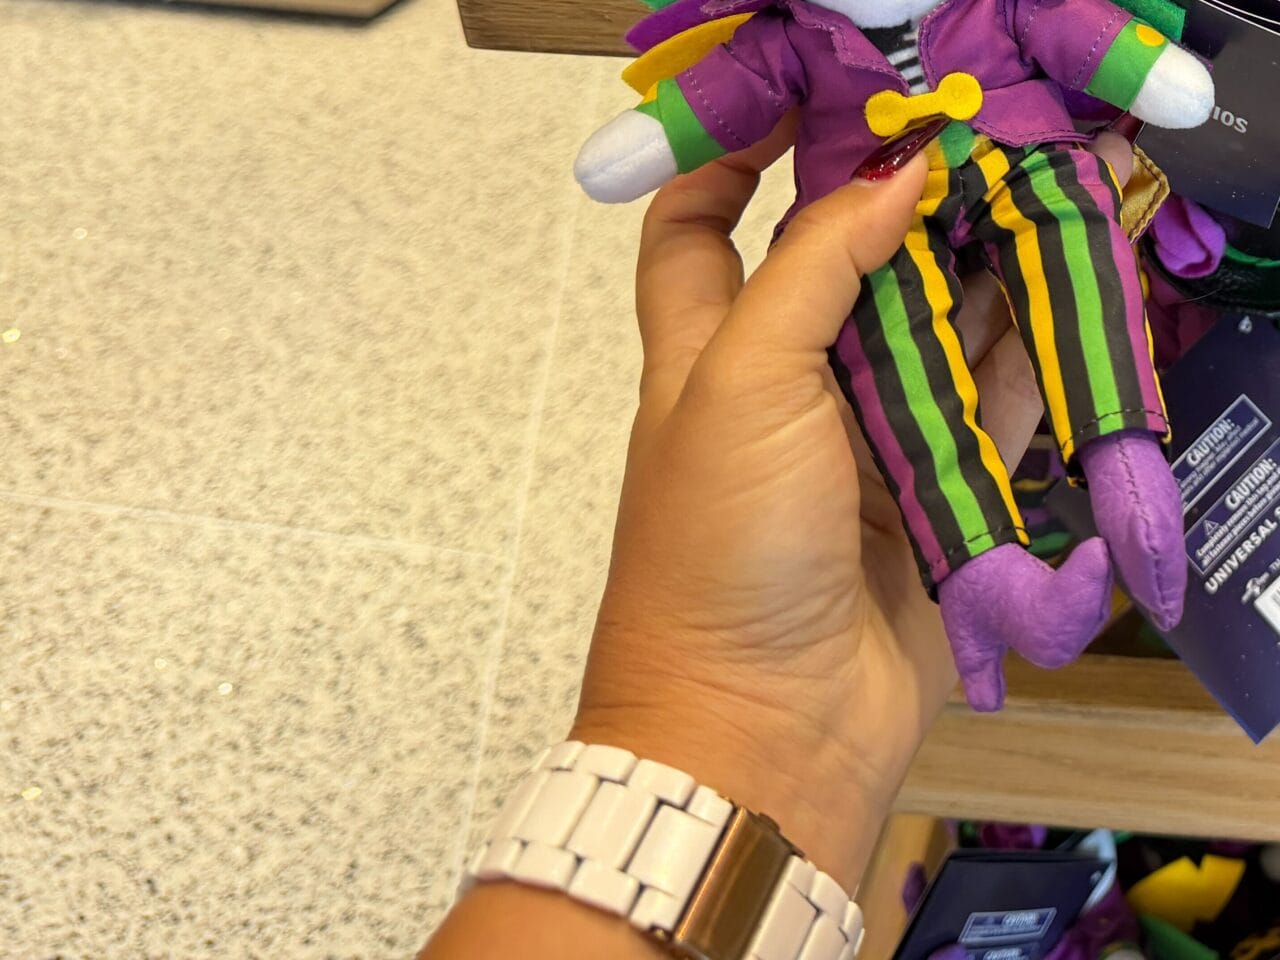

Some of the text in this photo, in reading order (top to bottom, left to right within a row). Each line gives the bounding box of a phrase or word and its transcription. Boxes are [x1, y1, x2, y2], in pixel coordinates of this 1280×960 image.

[1186, 418, 1235, 467] CAUTION:
[1225, 458, 1277, 510] CAUTION:
[1204, 517, 1277, 595] UNIVERSAL
